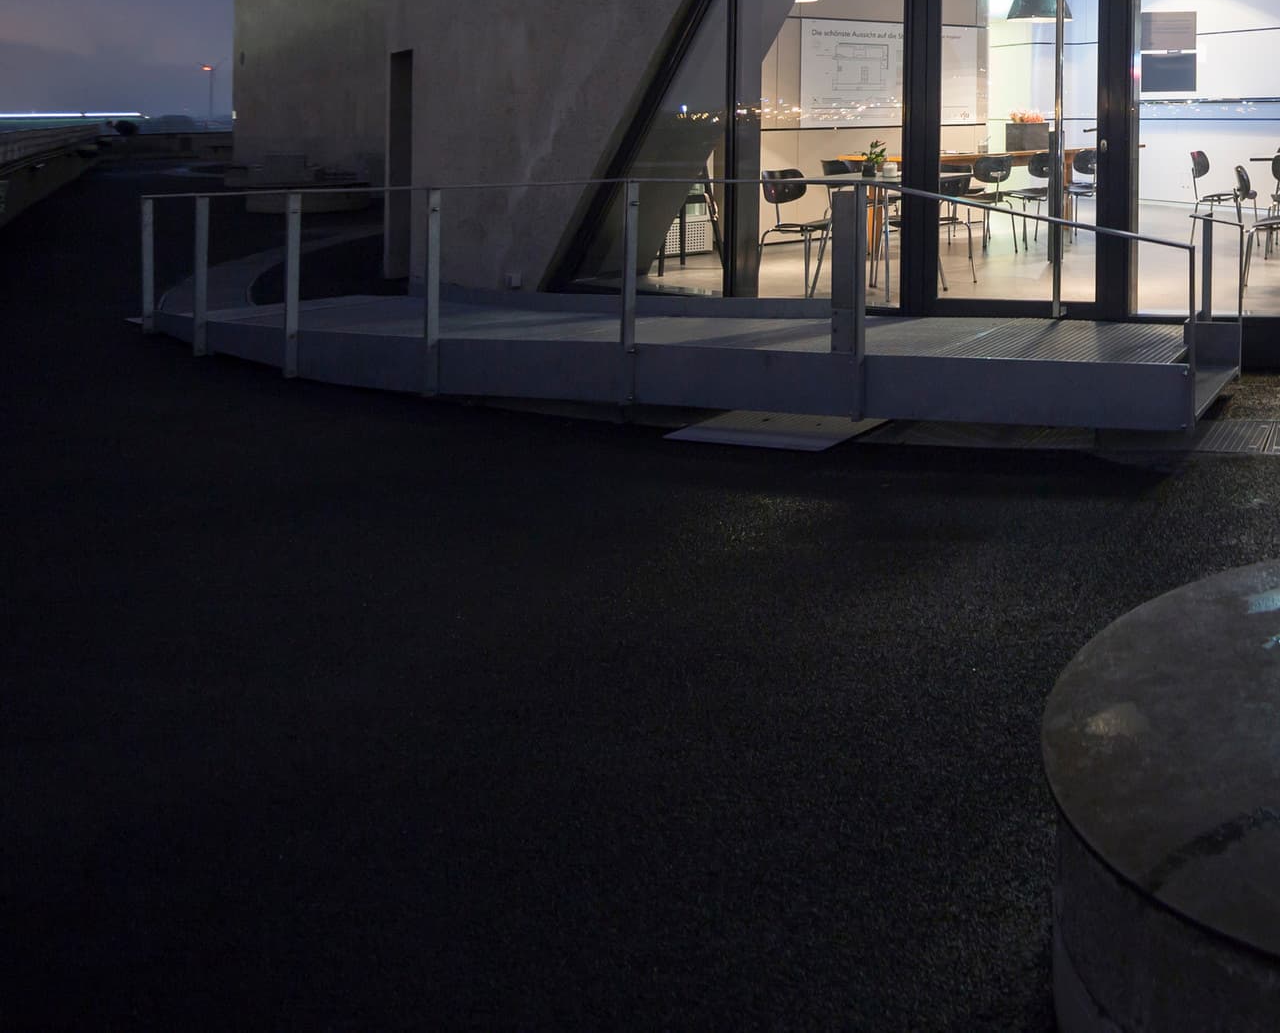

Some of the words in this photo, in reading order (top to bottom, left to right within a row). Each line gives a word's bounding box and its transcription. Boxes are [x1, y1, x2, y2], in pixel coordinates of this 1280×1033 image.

[811, 29, 822, 37] Die
[824, 29, 851, 38] schönste
[852, 31, 876, 39] Aussicht
[877, 31, 887, 39] auf
